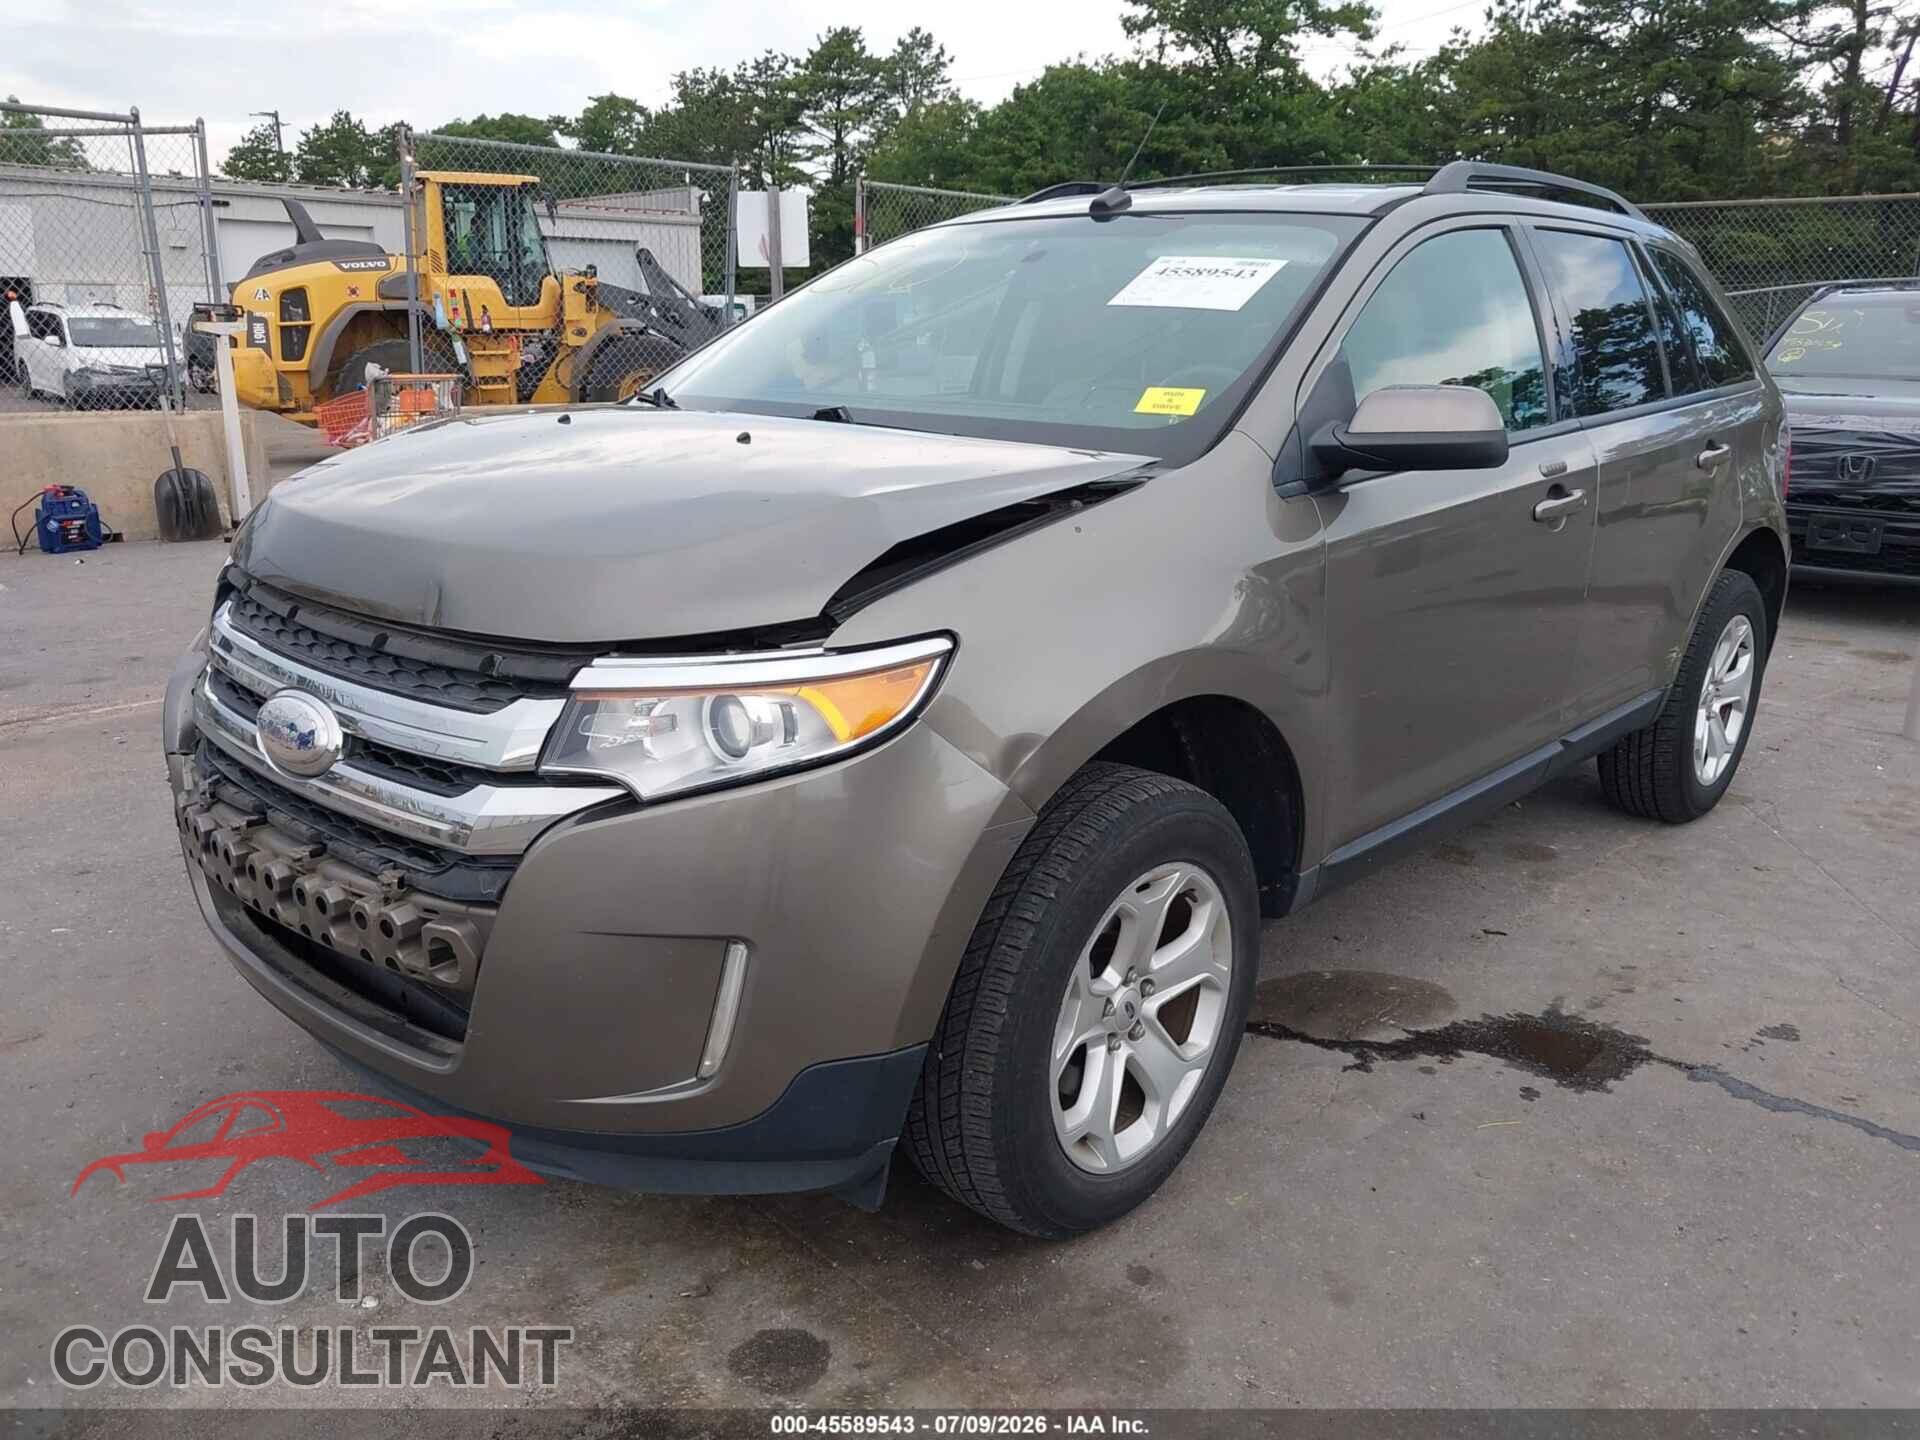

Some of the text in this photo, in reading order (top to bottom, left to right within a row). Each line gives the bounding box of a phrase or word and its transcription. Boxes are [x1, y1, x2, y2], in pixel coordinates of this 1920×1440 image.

[340, 261, 386, 269] VOLVO
[1155, 267, 1257, 279] 45589543
[253, 322, 266, 344] L90H
